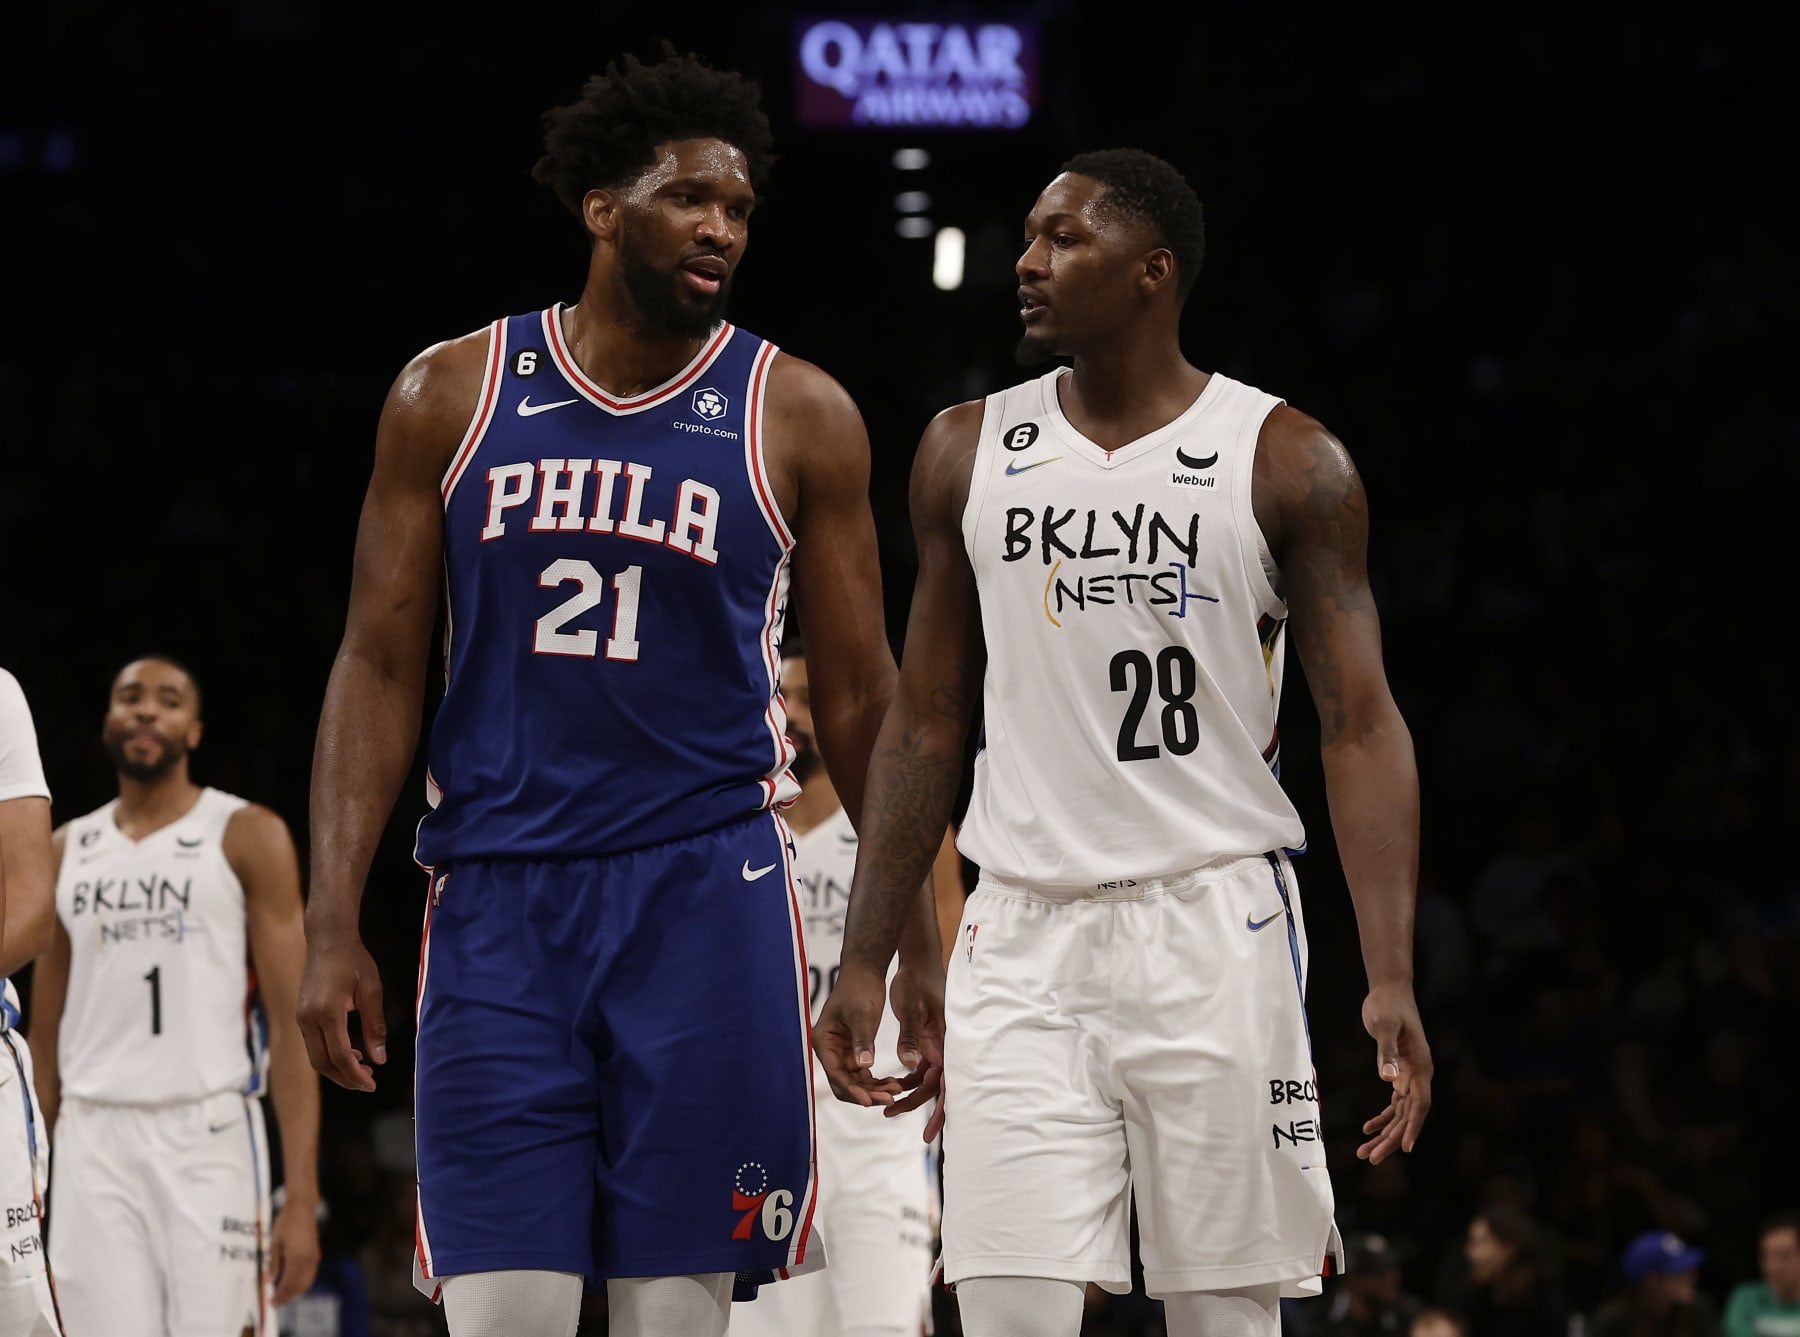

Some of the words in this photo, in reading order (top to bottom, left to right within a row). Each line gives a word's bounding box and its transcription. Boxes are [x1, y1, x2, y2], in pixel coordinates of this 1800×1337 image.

[801, 21, 1024, 97] QATAR
[516, 351, 537, 375] 6
[673, 421, 738, 440] crypto.com
[1011, 426, 1032, 447] 6
[1172, 473, 1215, 488] Webull
[480, 458, 721, 566] PHILA
[1002, 503, 1200, 568] BKLYN
[532, 558, 642, 662] 21
[1109, 645, 1200, 762] 28
[72, 874, 192, 917] BKLYN
[144, 964, 161, 1035] 1
[732, 1188, 793, 1241] 76
